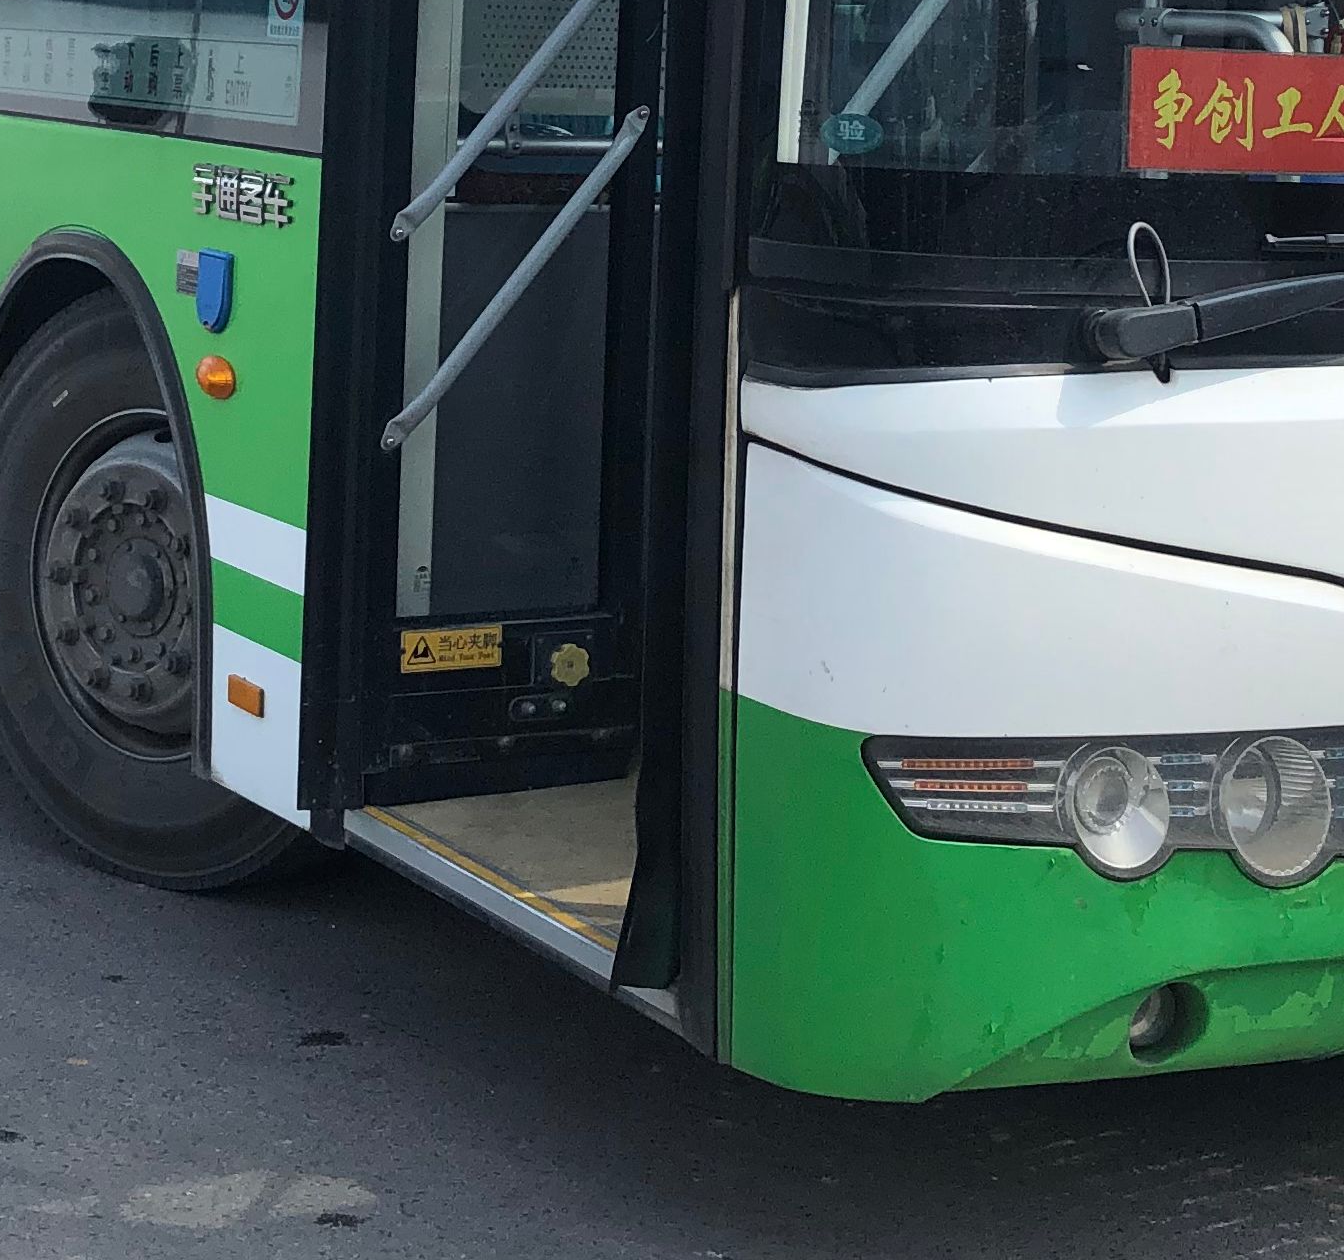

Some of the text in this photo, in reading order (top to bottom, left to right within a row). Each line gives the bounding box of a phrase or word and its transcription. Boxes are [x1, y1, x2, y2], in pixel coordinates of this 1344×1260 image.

[837, 120, 866, 140] 验
[192, 163, 294, 228] 宇通客车
[438, 632, 498, 651] 当心夹脚
